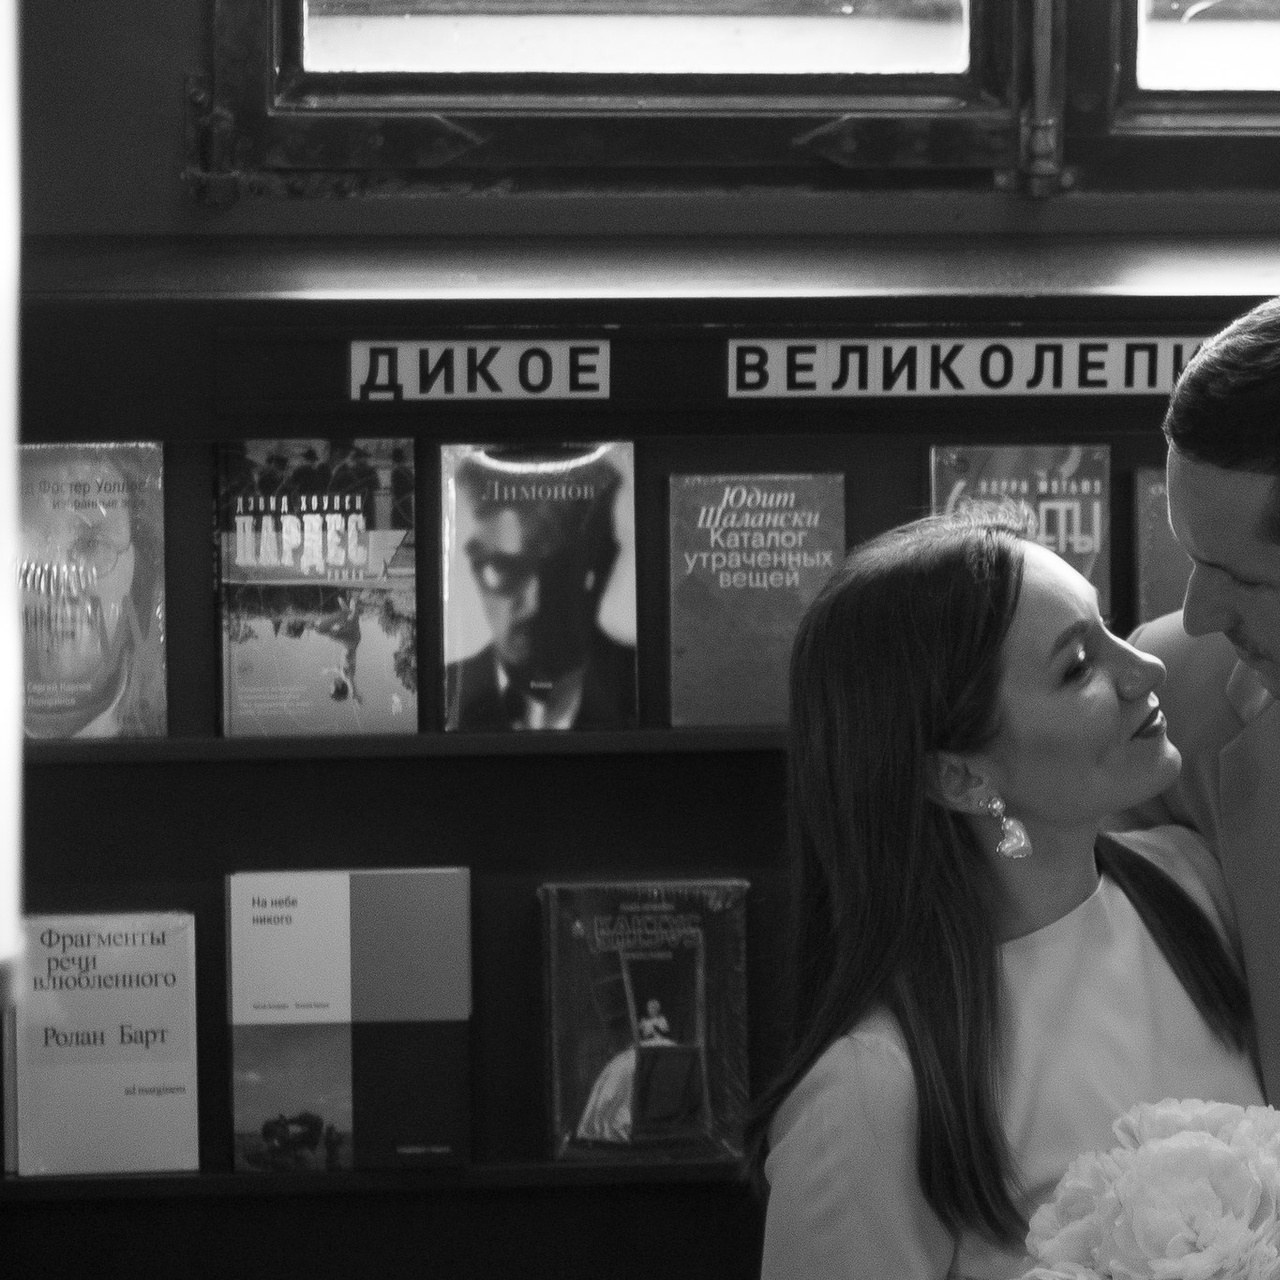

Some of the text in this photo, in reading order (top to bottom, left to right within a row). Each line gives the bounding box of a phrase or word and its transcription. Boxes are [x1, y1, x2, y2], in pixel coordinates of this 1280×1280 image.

[359, 345, 602, 402] ДИКОЕ
[482, 479, 596, 502] Лимонов
[720, 484, 797, 509] Юдит
[697, 506, 821, 529] Шалански
[234, 513, 367, 576] ПАРДЕС
[709, 527, 809, 549] Каталог
[683, 550, 834, 575] утраченных
[719, 566, 800, 591] вещей
[251, 895, 298, 909] На небе
[251, 914, 293, 926] никого
[40, 928, 167, 953] Фрагменты
[47, 955, 97, 977] речи
[33, 970, 177, 992] влюбленного
[43, 1023, 168, 1050] Ролан Барт
